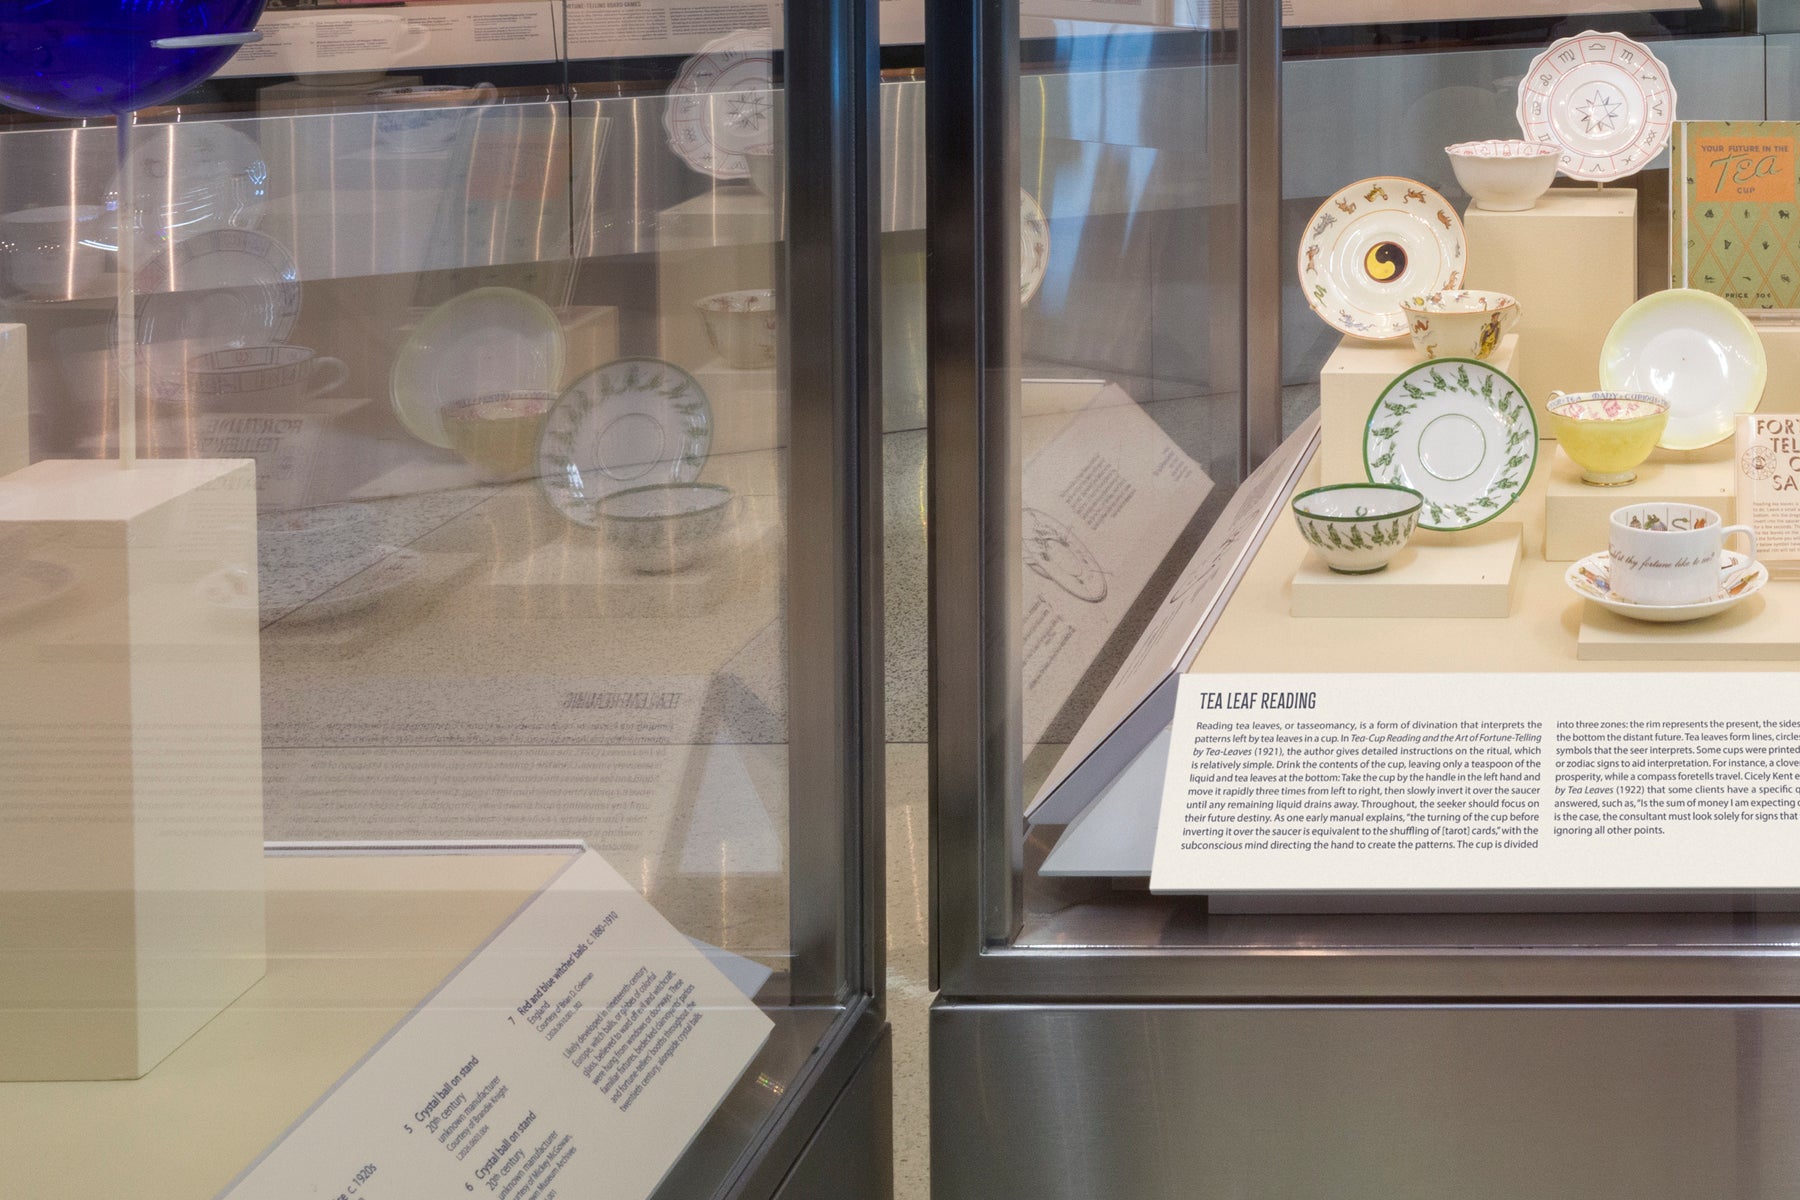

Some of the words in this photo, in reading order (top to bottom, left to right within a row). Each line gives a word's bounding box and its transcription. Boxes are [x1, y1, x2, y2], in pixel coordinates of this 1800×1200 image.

[1701, 145, 1724, 153] YOUR
[1728, 145, 1760, 153] FUTURE
[1624, 555, 1638, 570] thy
[1640, 557, 1672, 573] fortune
[1675, 557, 1690, 569] like
[1200, 692, 1223, 710] TEA
[1226, 692, 1258, 710] LEAF
[1260, 691, 1317, 710] READING
[1196, 721, 1234, 732] Reading
[1235, 722, 1250, 730] tea
[1252, 721, 1283, 731] leaves,
[1296, 721, 1357, 732] tasseomancy,
[1359, 721, 1367, 730] is
[1368, 722, 1375, 730] a
[1376, 720, 1399, 730] form
[1400, 720, 1411, 730] of
[1411, 720, 1458, 730] divination
[1460, 720, 1479, 729] that
[1480, 720, 1525, 731] interprets
[1526, 720, 1543, 729] the
[1553, 825, 1593, 837] ignoring
[1594, 825, 1606, 835] all
[1606, 825, 1633, 835] other
[1633, 825, 1665, 837] points.
[516, 999, 533, 1016] Red
[529, 987, 544, 1005] and
[538, 977, 556, 993] blue
[571, 943, 589, 960] balls
[507, 1015, 516, 1025] 7
[526, 999, 551, 1025] England
[414, 1095, 442, 1123] Crystal
[436, 1082, 454, 1100] ball
[450, 1074, 463, 1087] on
[459, 1055, 480, 1078] stand
[437, 1113, 467, 1144] unknown
[463, 1075, 501, 1116] manufacturer
[440, 1092, 467, 1120] century
[405, 1126, 414, 1135] 5
[474, 1152, 501, 1180] Crystal
[495, 1139, 512, 1157] ball
[508, 1130, 521, 1143] on
[517, 1110, 537, 1134] stand
[353, 1163, 378, 1186] 1920s
[465, 1183, 474, 1192] 6
